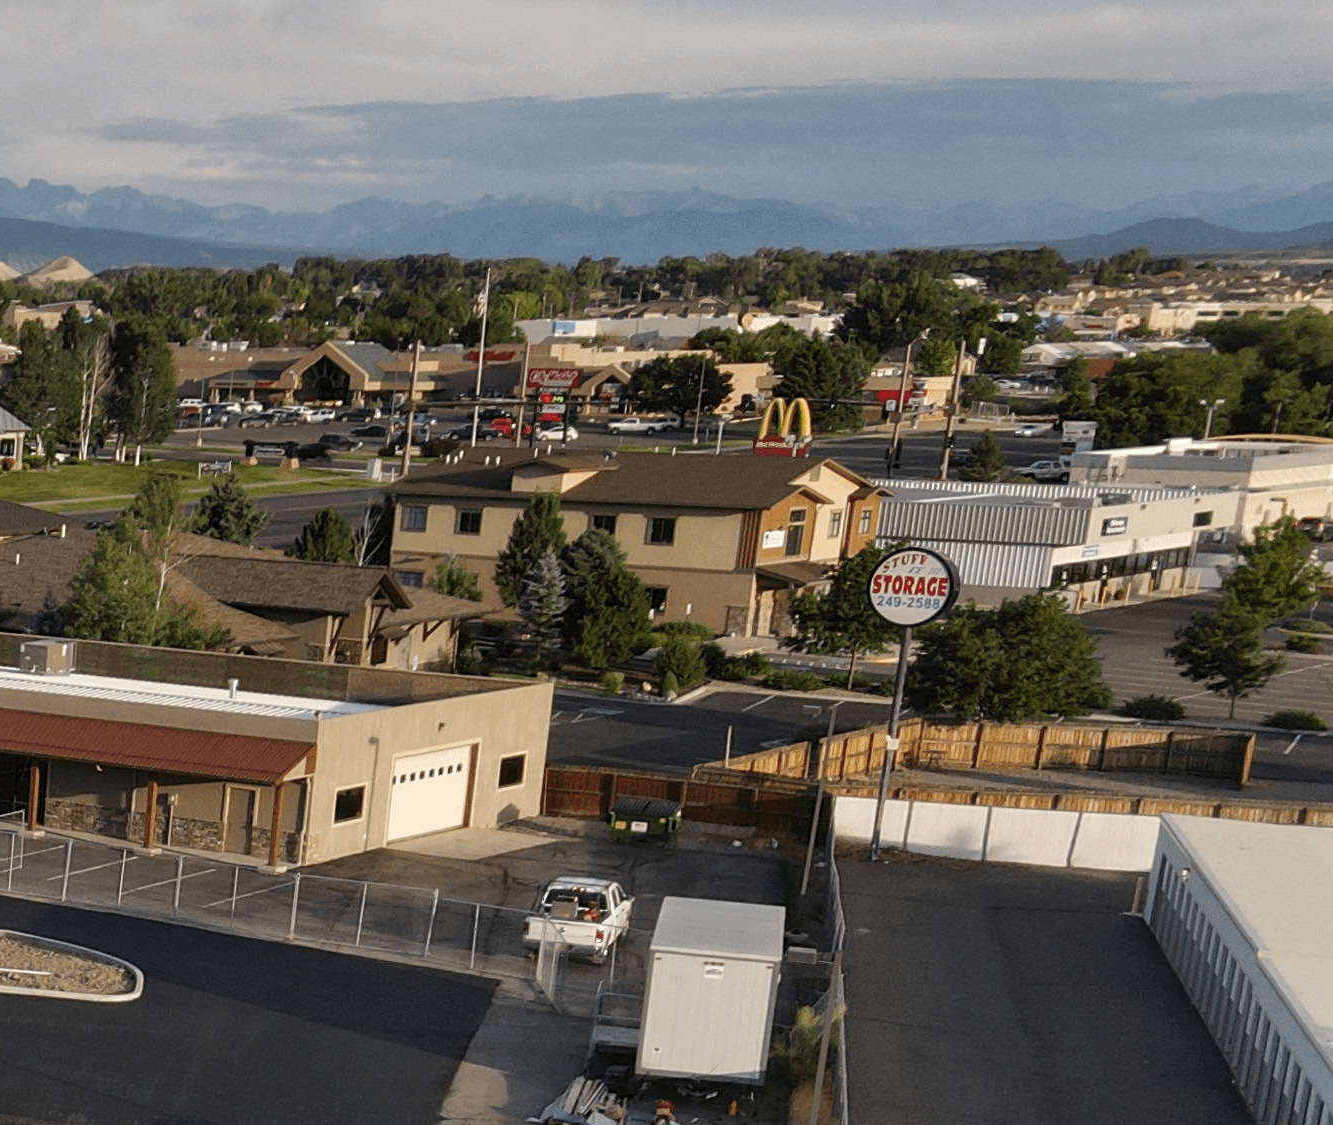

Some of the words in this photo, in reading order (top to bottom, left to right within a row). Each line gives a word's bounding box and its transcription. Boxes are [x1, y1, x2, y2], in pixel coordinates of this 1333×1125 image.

[882, 553, 928, 573] STUFF
[872, 574, 949, 597] STORAGE
[876, 595, 941, 610] 249-2588
